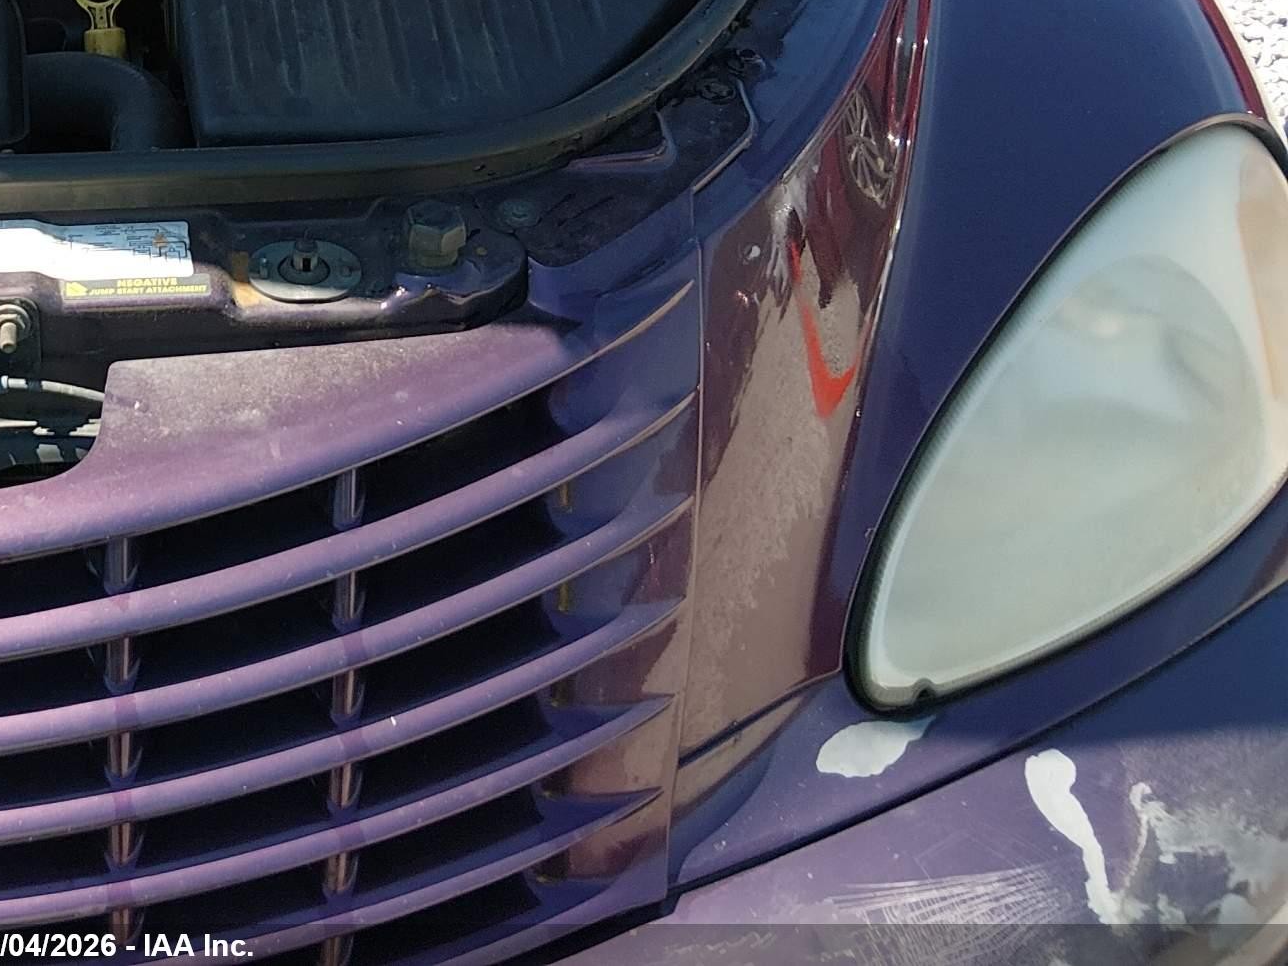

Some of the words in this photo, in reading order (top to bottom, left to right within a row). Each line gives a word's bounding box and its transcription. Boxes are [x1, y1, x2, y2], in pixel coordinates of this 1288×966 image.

[117, 277, 178, 287] NEGATIVE
[89, 288, 115, 296] JUMP
[117, 287, 145, 295] START
[145, 285, 207, 294] ATTACHMENT
